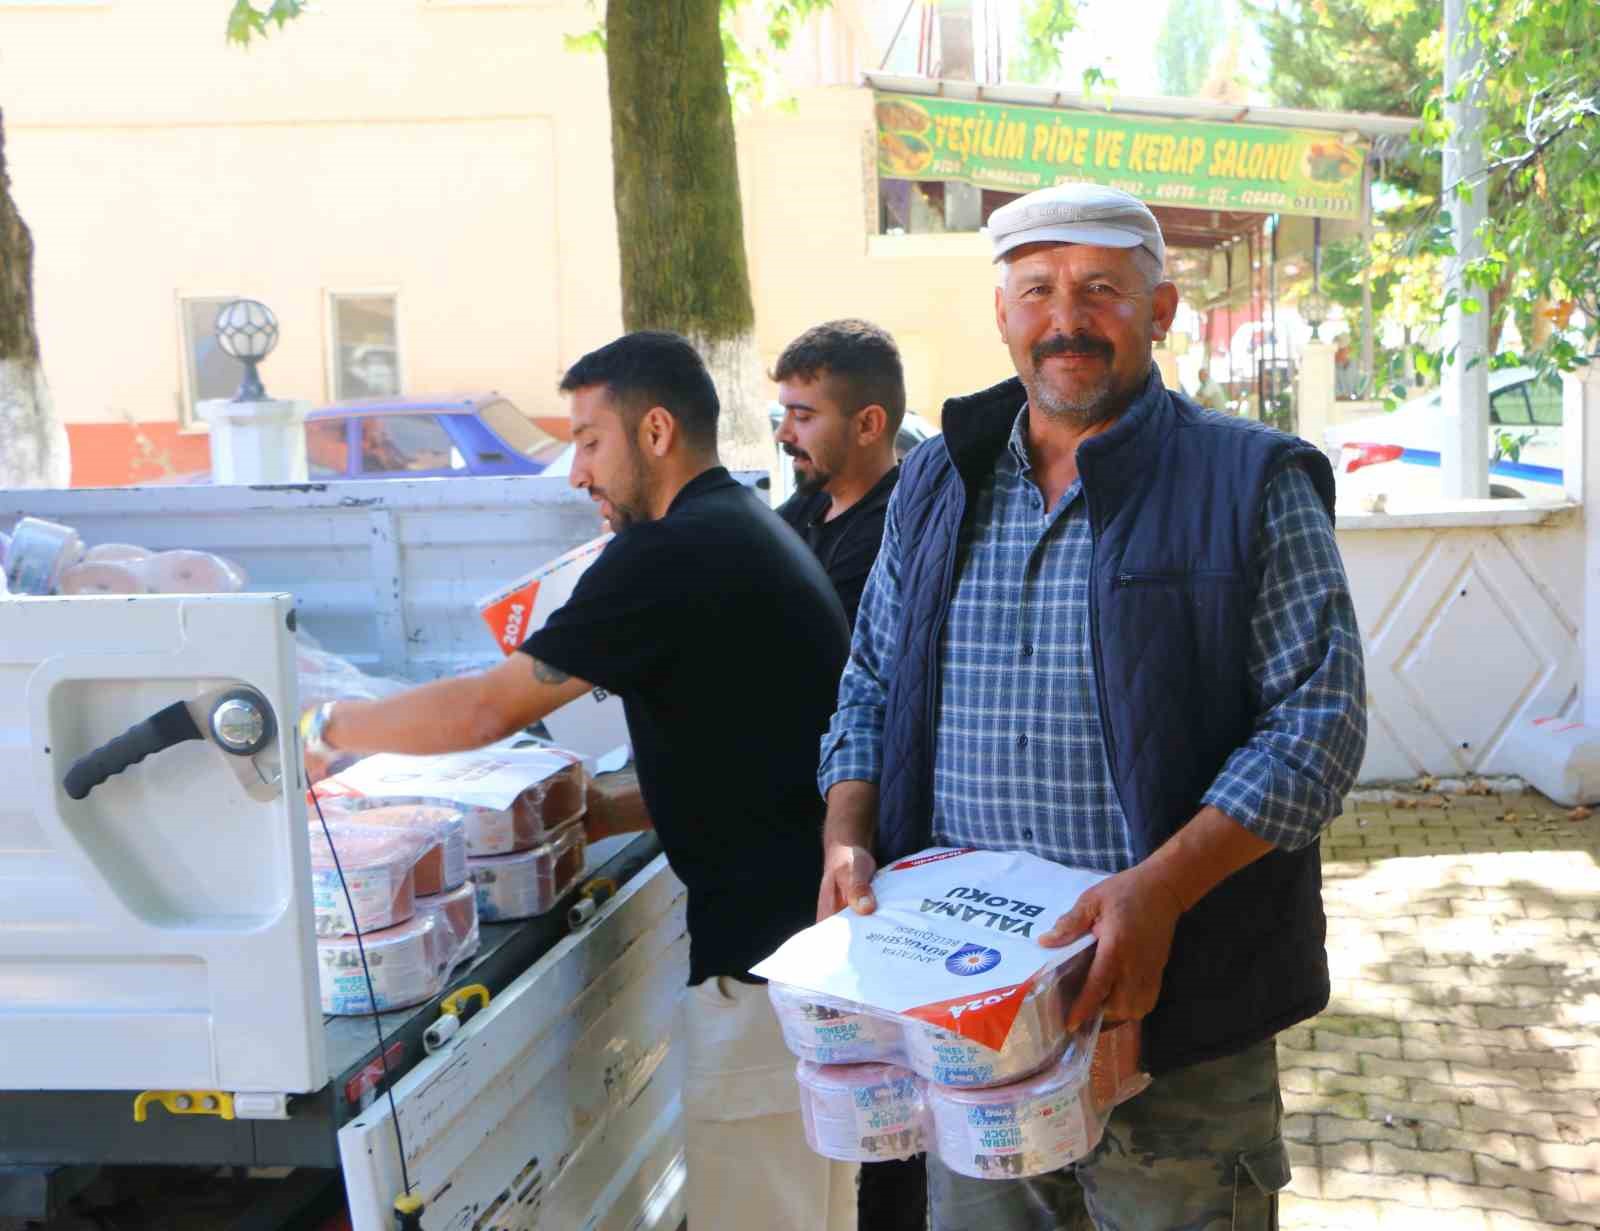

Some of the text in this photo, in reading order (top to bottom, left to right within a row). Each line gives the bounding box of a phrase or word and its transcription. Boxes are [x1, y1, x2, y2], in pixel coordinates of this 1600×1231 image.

[934, 110, 1297, 181] YEŞİLİM PİDE VE KEBAP SALONU
[503, 604, 526, 646] 2024
[919, 898, 1035, 938] YALAMA
[945, 886, 1046, 917] BLOKU
[983, 1126, 1022, 1139] BLOCK
